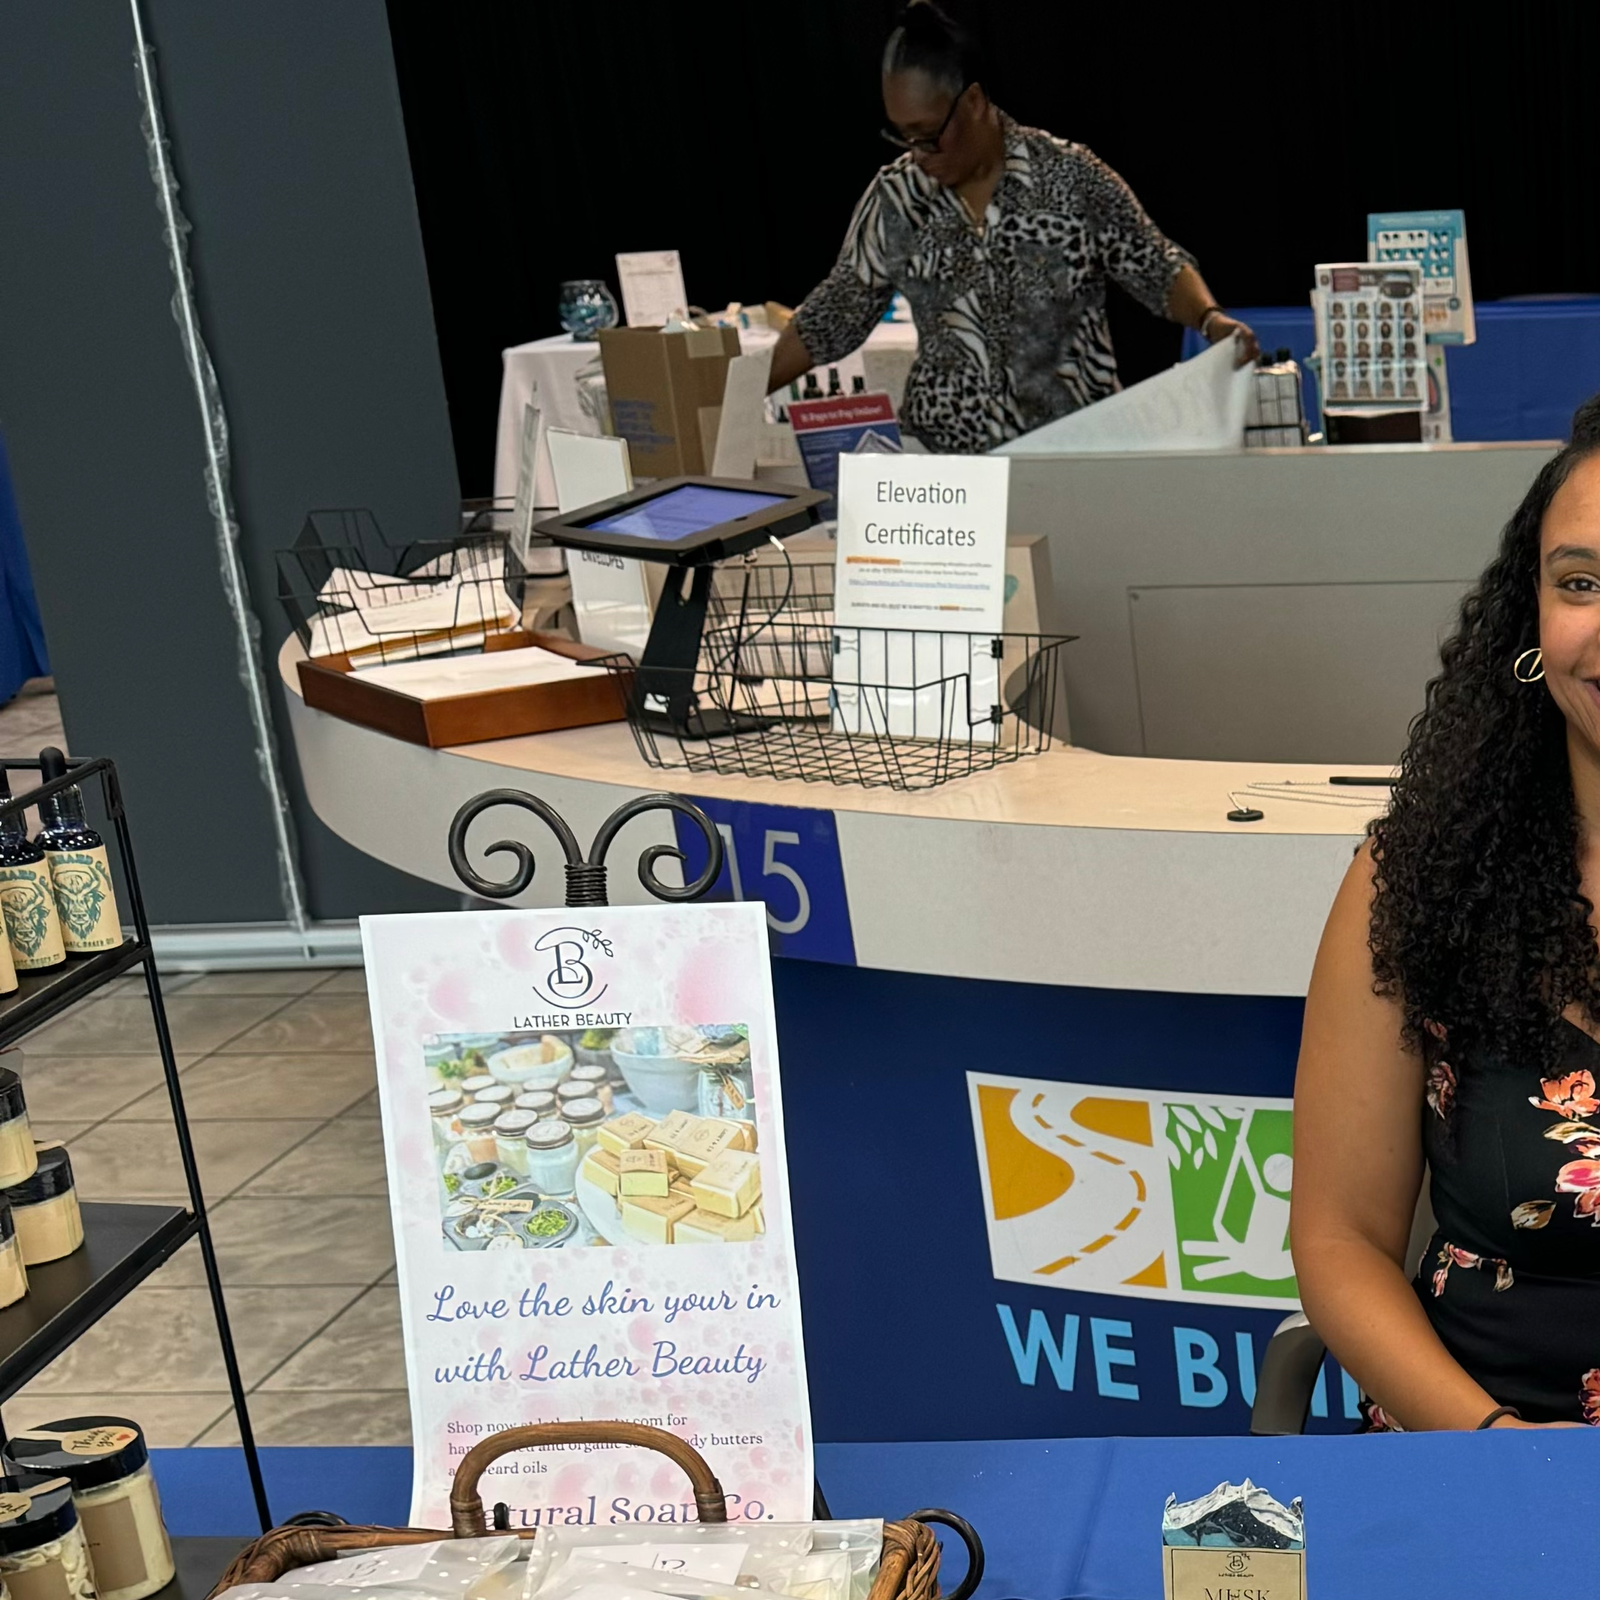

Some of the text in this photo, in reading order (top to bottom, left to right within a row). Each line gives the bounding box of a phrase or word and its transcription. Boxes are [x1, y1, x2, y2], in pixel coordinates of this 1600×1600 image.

[877, 480, 967, 504] Elevation
[865, 522, 976, 547] Certificates
[715, 823, 811, 934] 15
[514, 1011, 633, 1029] LATHER BEAUTY
[426, 1280, 781, 1323] Love the skin your in
[434, 1340, 767, 1384] with Lather Beauty
[996, 1303, 1140, 1401] WE
[447, 1421, 483, 1436] Shop
[667, 1413, 688, 1426] for
[711, 1431, 763, 1447] butters
[523, 1460, 548, 1474] oils
